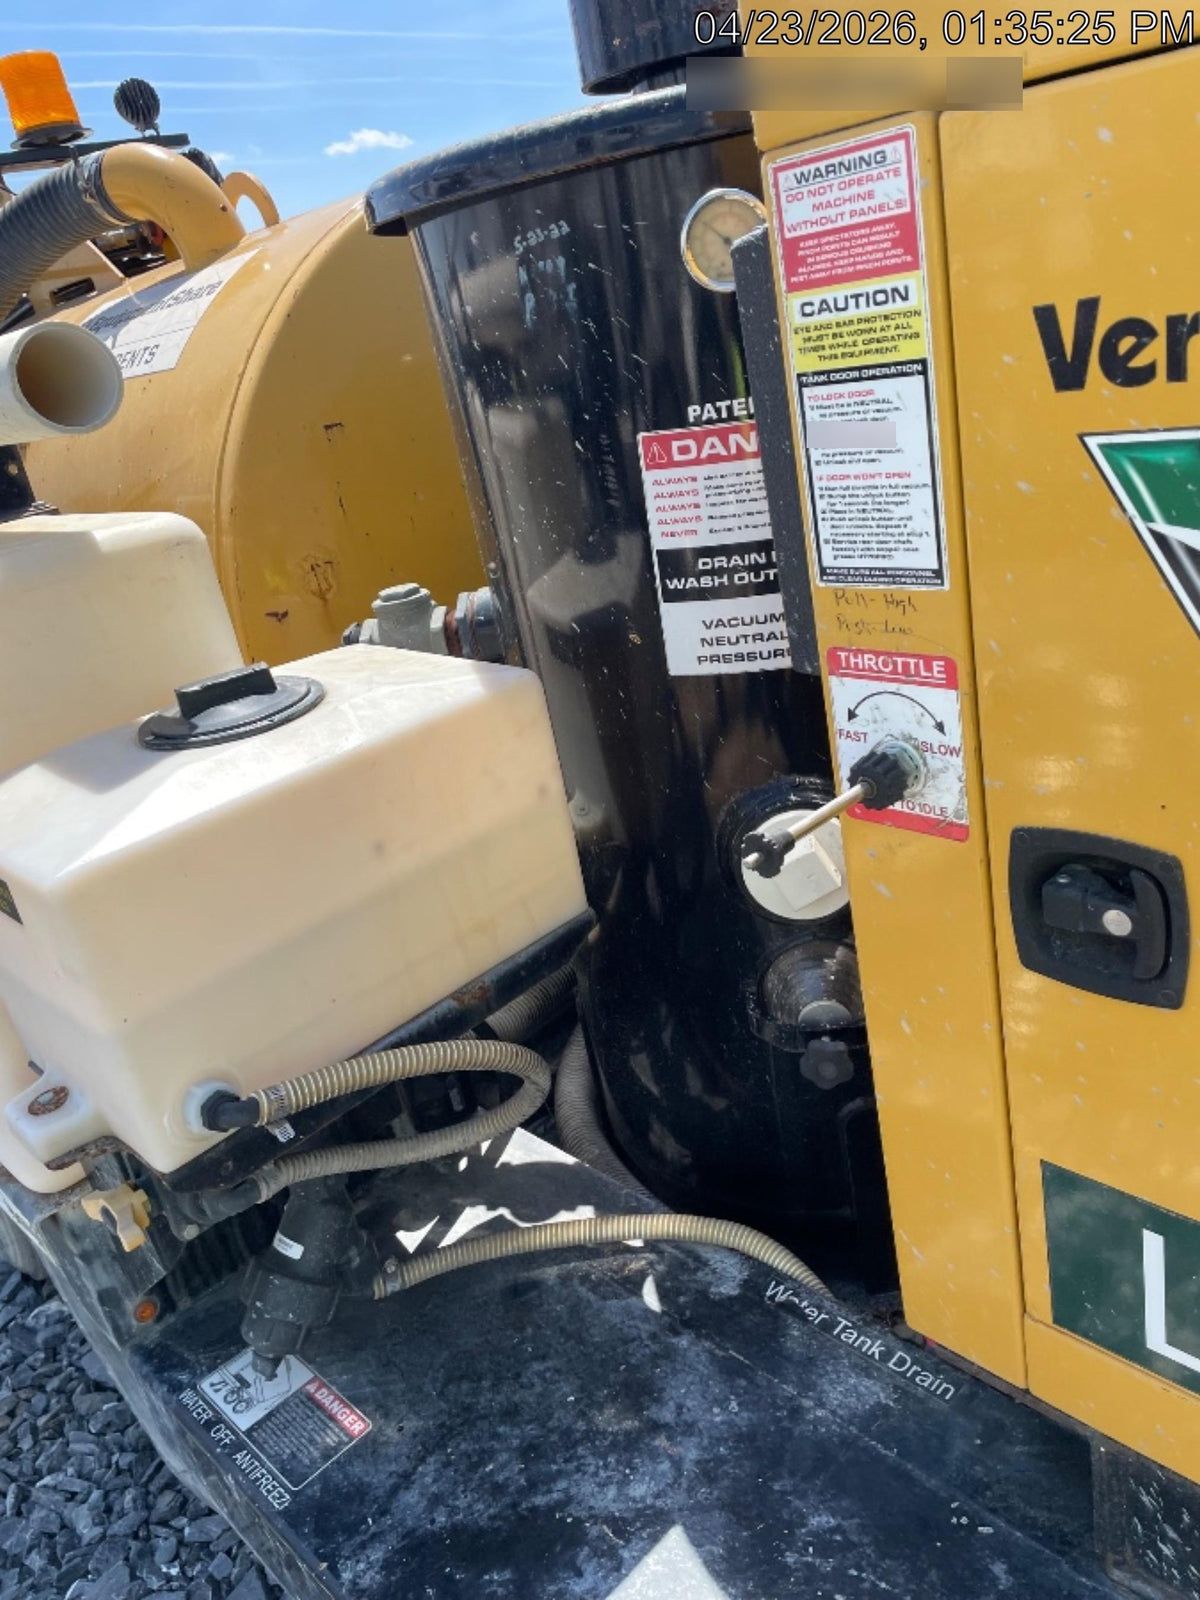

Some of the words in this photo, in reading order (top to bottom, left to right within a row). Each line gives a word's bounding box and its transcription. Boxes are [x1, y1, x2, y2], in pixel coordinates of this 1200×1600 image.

[794, 151, 886, 184] WARNING
[786, 192, 804, 203] DO
[807, 183, 835, 199] NOT
[838, 167, 901, 191] OPERATE
[812, 190, 875, 212] MACHINE
[786, 212, 845, 233] WITHOUT
[850, 199, 907, 219] PANELS!
[800, 285, 909, 317] CAUTION
[794, 325, 811, 334] EYE
[813, 322, 832, 331] AND
[857, 309, 921, 324] PROTECTION
[803, 334, 829, 343] MUST
[832, 331, 844, 340] BE
[846, 326, 877, 337] WORN
[880, 324, 891, 332] AT
[828, 341, 858, 351] WHILE
[862, 332, 920, 346] OPERATING
[801, 375, 828, 384] TANK
[830, 370, 859, 381] DOOR
[862, 363, 922, 377] OPERATION
[821, 392, 845, 400] LOCK
[848, 389, 875, 398] DOOR
[671, 430, 758, 462] DAN
[652, 476, 697, 486] ALWAYS
[654, 489, 699, 499] ALWAYS
[656, 503, 701, 512] ALWAYS
[657, 516, 702, 525] ALWAYS
[698, 552, 766, 570] DRAIN
[665, 574, 728, 589] WASH
[734, 569, 779, 584] OUT
[702, 613, 785, 630] VACUUM
[700, 631, 789, 648] NEUTRAL
[837, 651, 947, 678] THROTTLE
[838, 728, 868, 743] FAST
[920, 741, 962, 758] SLOW
[832, 1317, 886, 1360] Tank
[888, 1351, 956, 1400] Drain
[179, 1388, 213, 1425] WATER
[315, 1388, 366, 1435] DANGER
